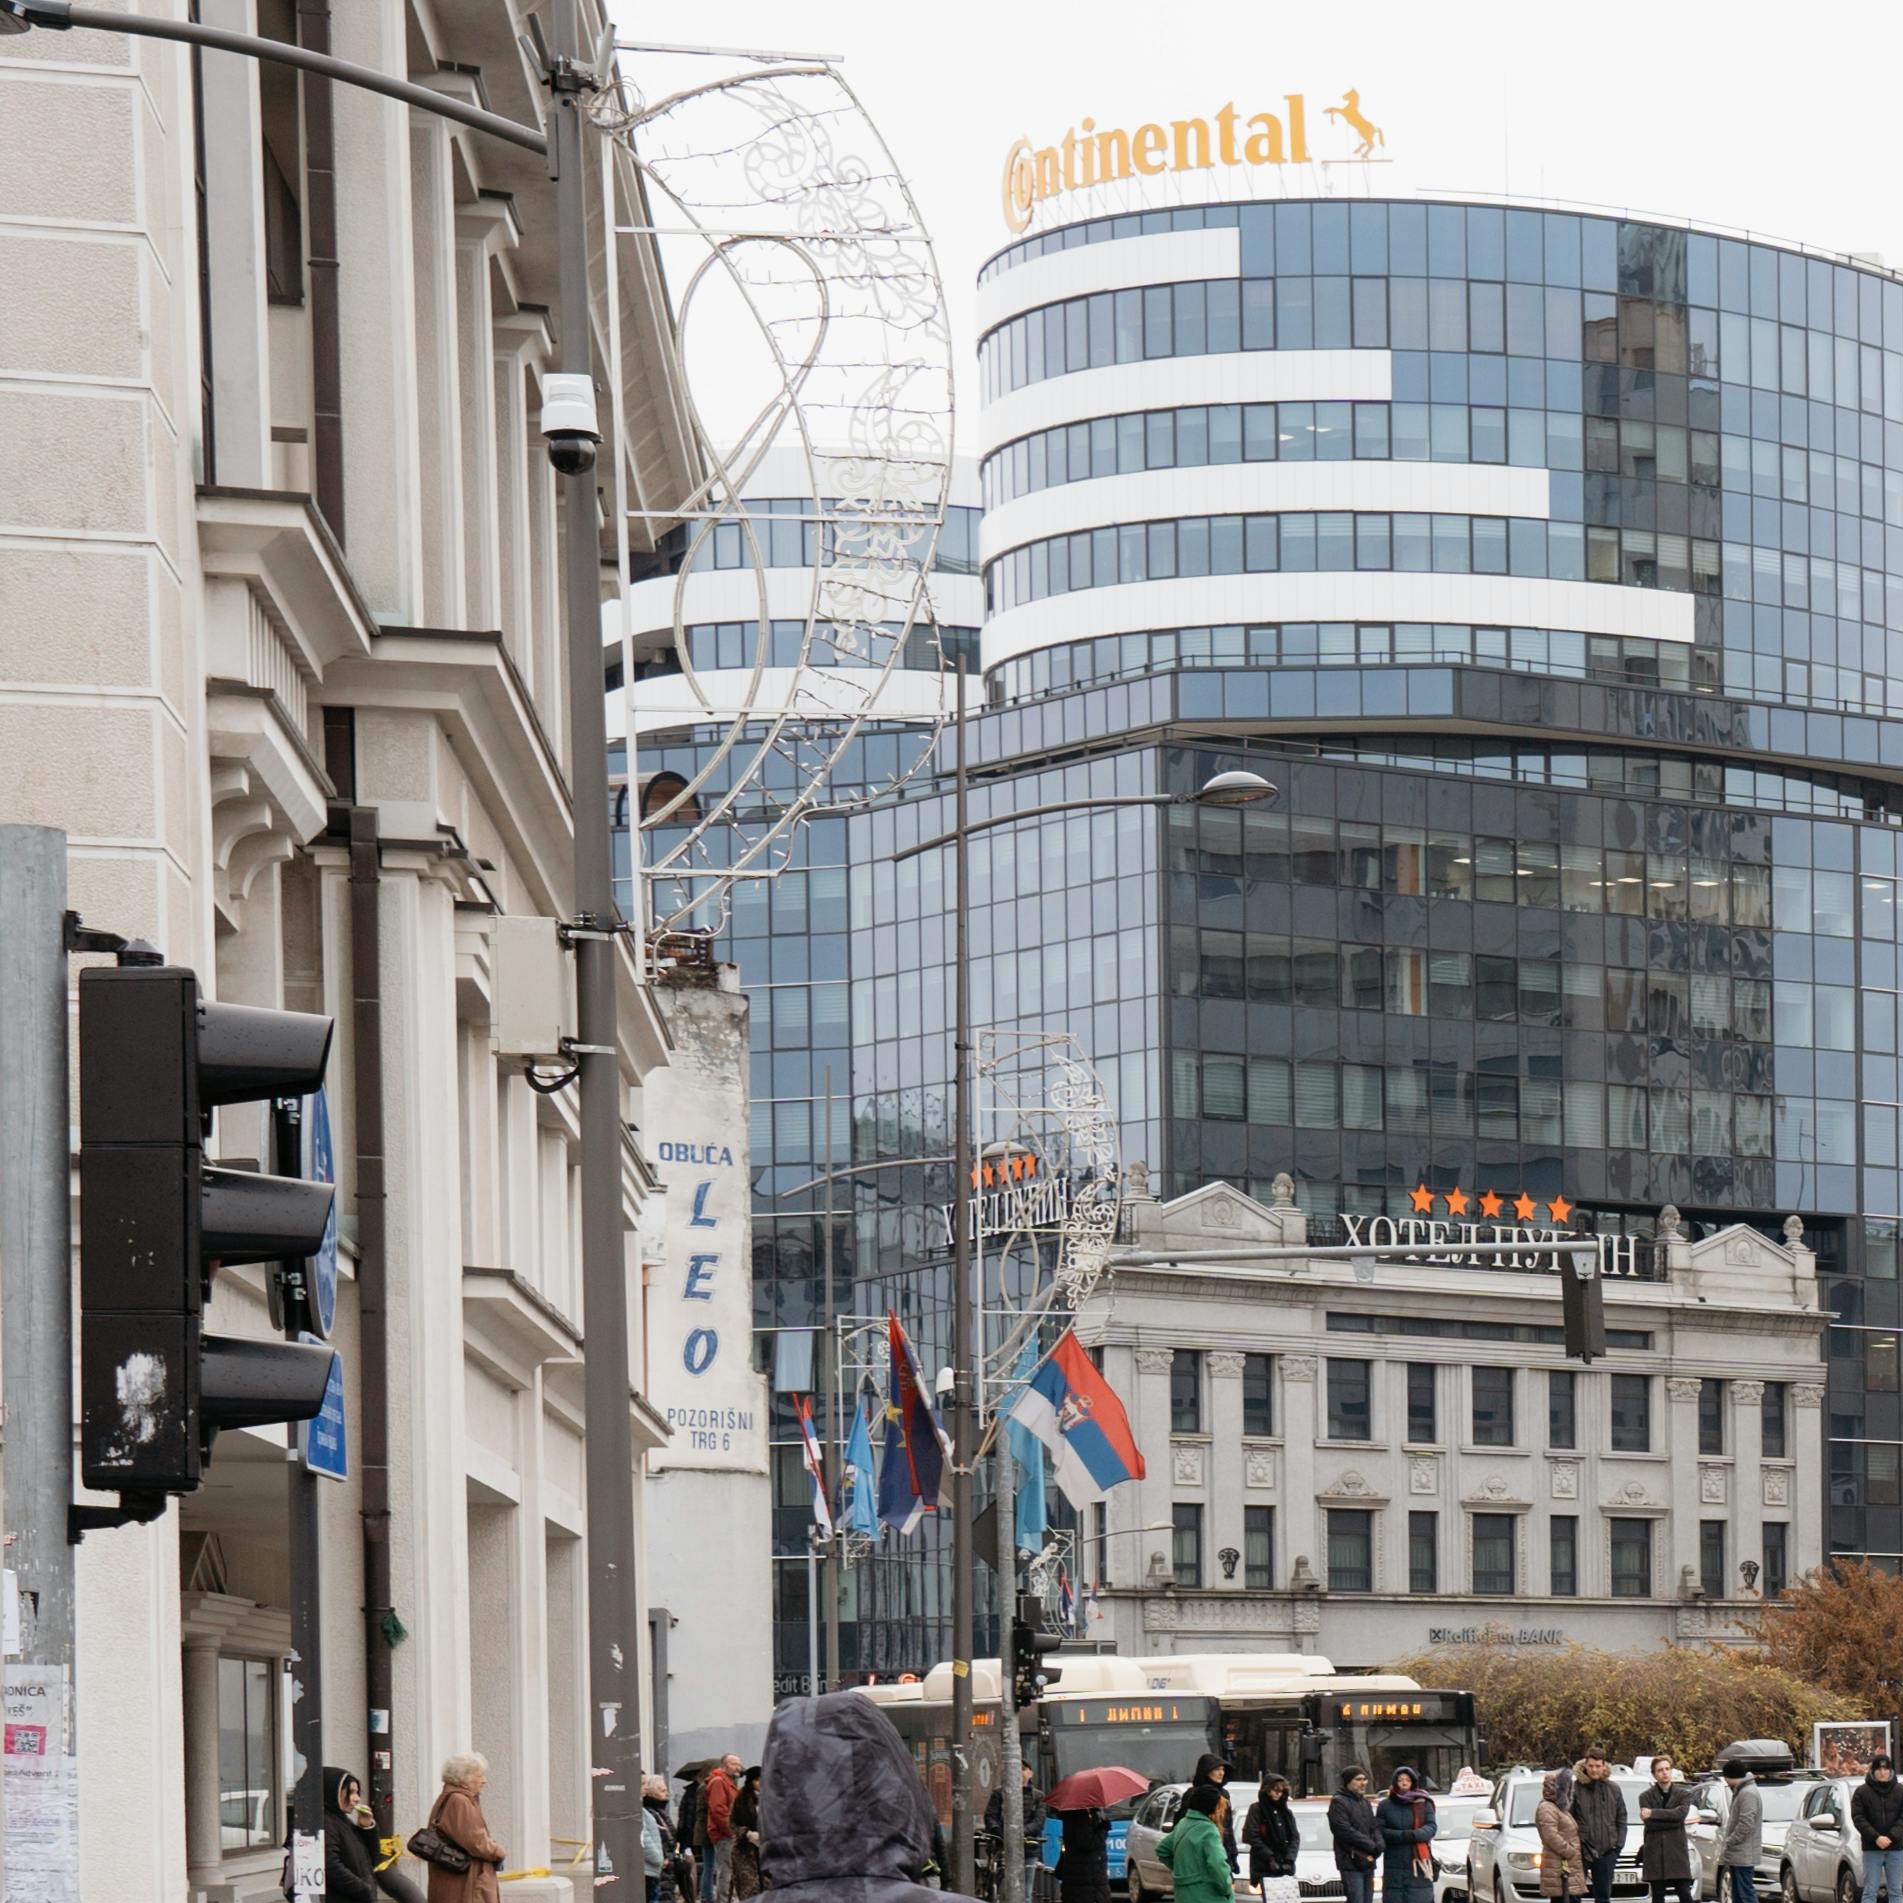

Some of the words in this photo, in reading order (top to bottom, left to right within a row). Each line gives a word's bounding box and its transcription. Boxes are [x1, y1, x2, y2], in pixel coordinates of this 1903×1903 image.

[1001, 94, 1312, 233] Continental
[658, 1141, 734, 1167] OBUĆA
[682, 1178, 721, 1378] LEO
[667, 1406, 754, 1430] POZORIŠNI
[690, 1430, 718, 1450] TRG
[722, 1432, 731, 1451] 6
